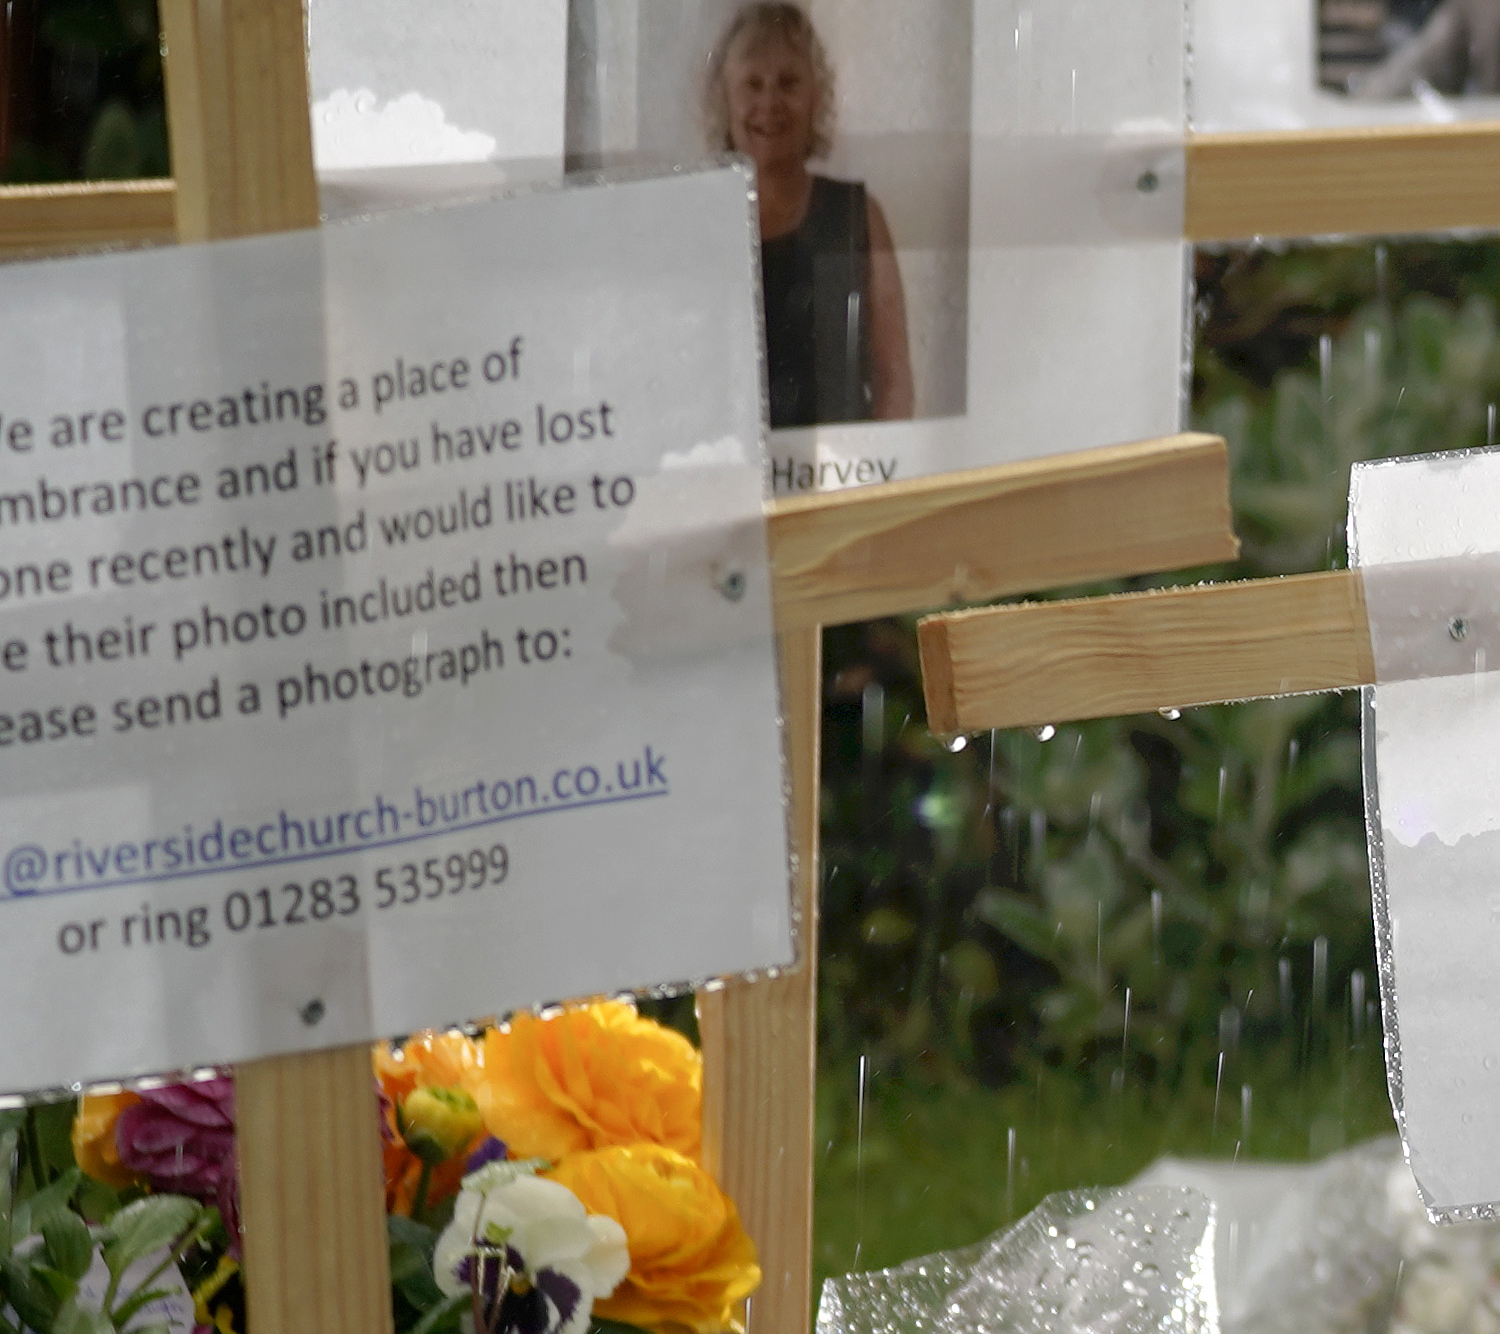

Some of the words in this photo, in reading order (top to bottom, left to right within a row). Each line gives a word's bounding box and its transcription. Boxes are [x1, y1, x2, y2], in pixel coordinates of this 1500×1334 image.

[50, 409, 126, 449] are
[142, 381, 328, 438] creating
[338, 378, 360, 410] a
[372, 355, 470, 412] place
[482, 335, 526, 386] of
[0, 472, 201, 525] mbrance
[216, 447, 300, 500] and
[313, 441, 342, 485] if
[349, 439, 420, 487] you
[431, 416, 521, 467] have
[536, 398, 615, 447] lost
[771, 455, 897, 493] Harvey
[89, 526, 277, 588] recently
[291, 511, 368, 565] and
[380, 485, 493, 545] would
[504, 476, 576, 525] like
[589, 469, 636, 509] to
[44, 615, 155, 667] their
[172, 601, 306, 662] photo
[320, 559, 482, 629] included
[493, 547, 587, 595] then
[112, 675, 222, 733] send
[237, 682, 262, 716] a
[277, 633, 506, 719] photograph
[516, 627, 574, 665] to:
[3, 745, 668, 897] @riversidechurch-burton.co.uk
[57, 918, 105, 955] or
[121, 902, 211, 948] ring
[223, 873, 361, 932] 01283
[373, 843, 509, 911] 535999
